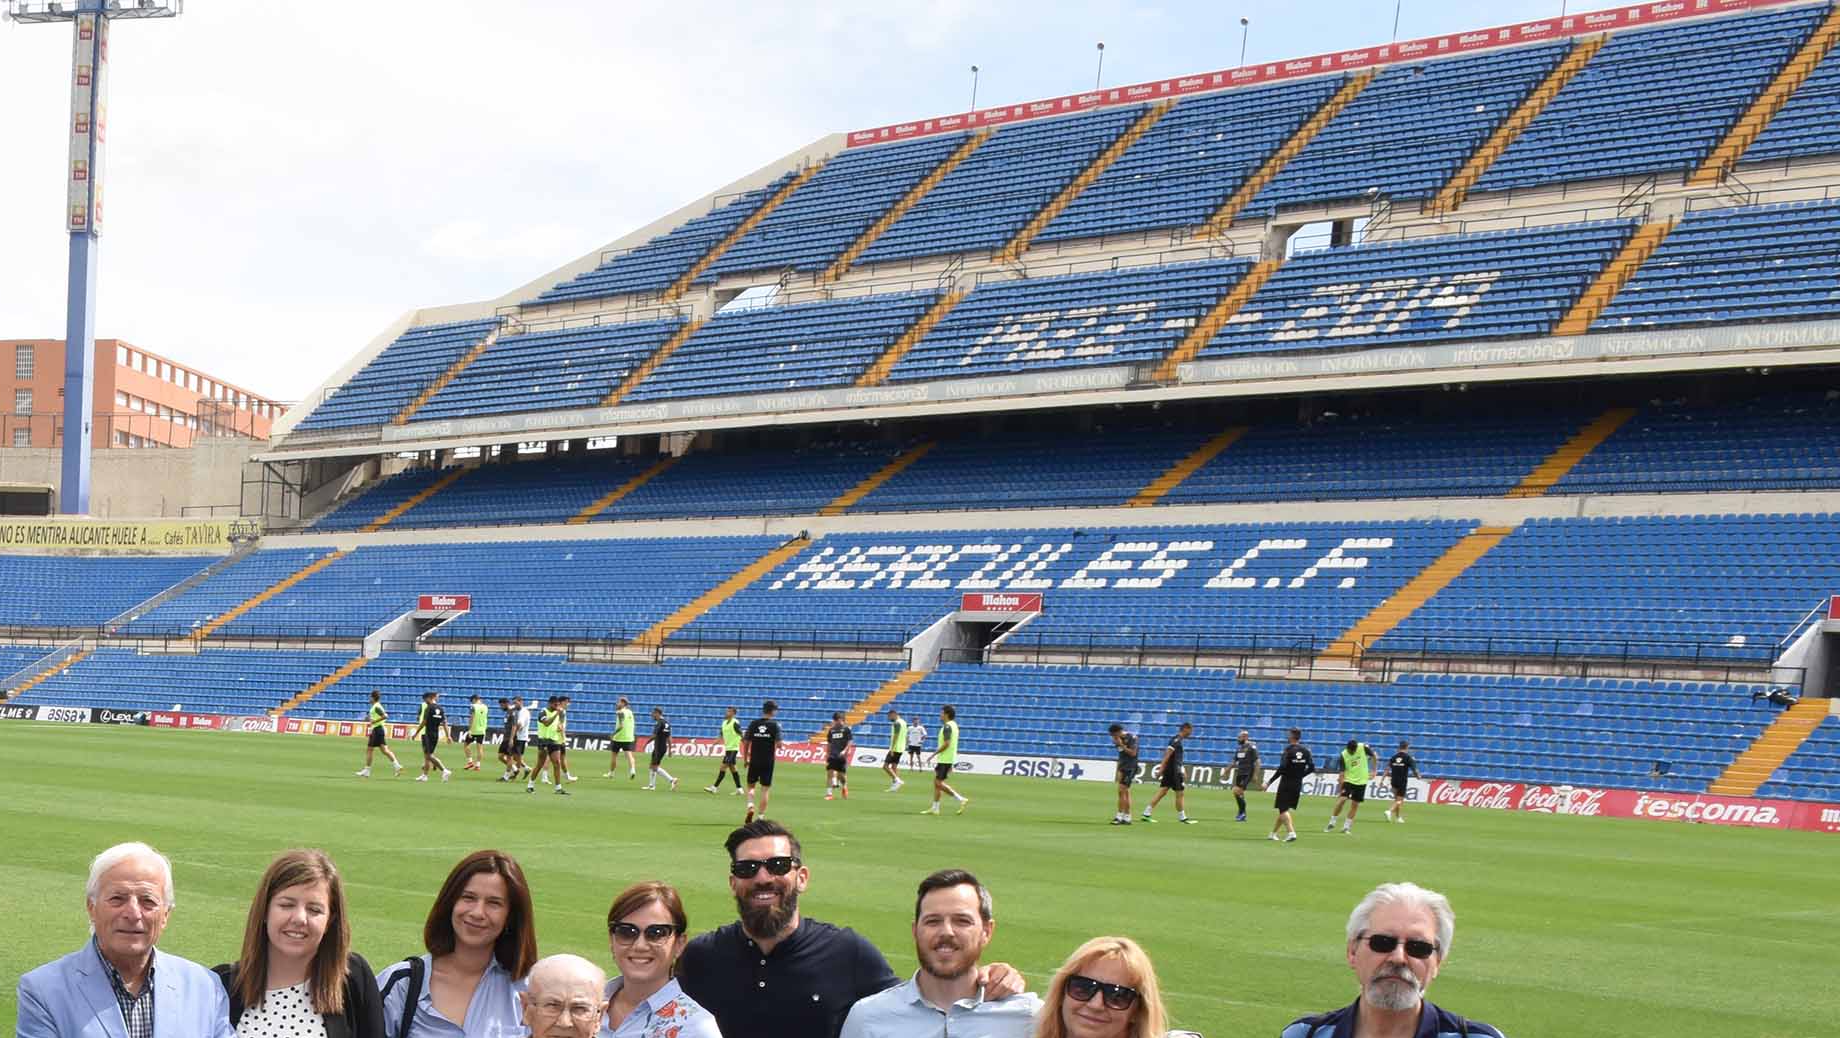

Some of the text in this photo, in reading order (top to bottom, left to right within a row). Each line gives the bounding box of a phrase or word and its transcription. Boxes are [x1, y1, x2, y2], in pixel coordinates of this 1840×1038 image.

[0, 525, 12, 543] NO
[15, 526, 24, 543] ES
[27, 526, 67, 544] MENTIRA
[69, 526, 110, 544] ALICANTE
[112, 527, 137, 544] HUELE
[165, 531, 183, 544] Cafés
[768, 542, 1215, 590] HERCULES
[982, 594, 1019, 605] Mahou
[47, 708, 78, 722] asisa
[112, 713, 136, 722] LEXU
[775, 746, 812, 763] Grupo
[1002, 760, 1065, 779] asisa
[1432, 781, 1516, 809] Coca-Cola
